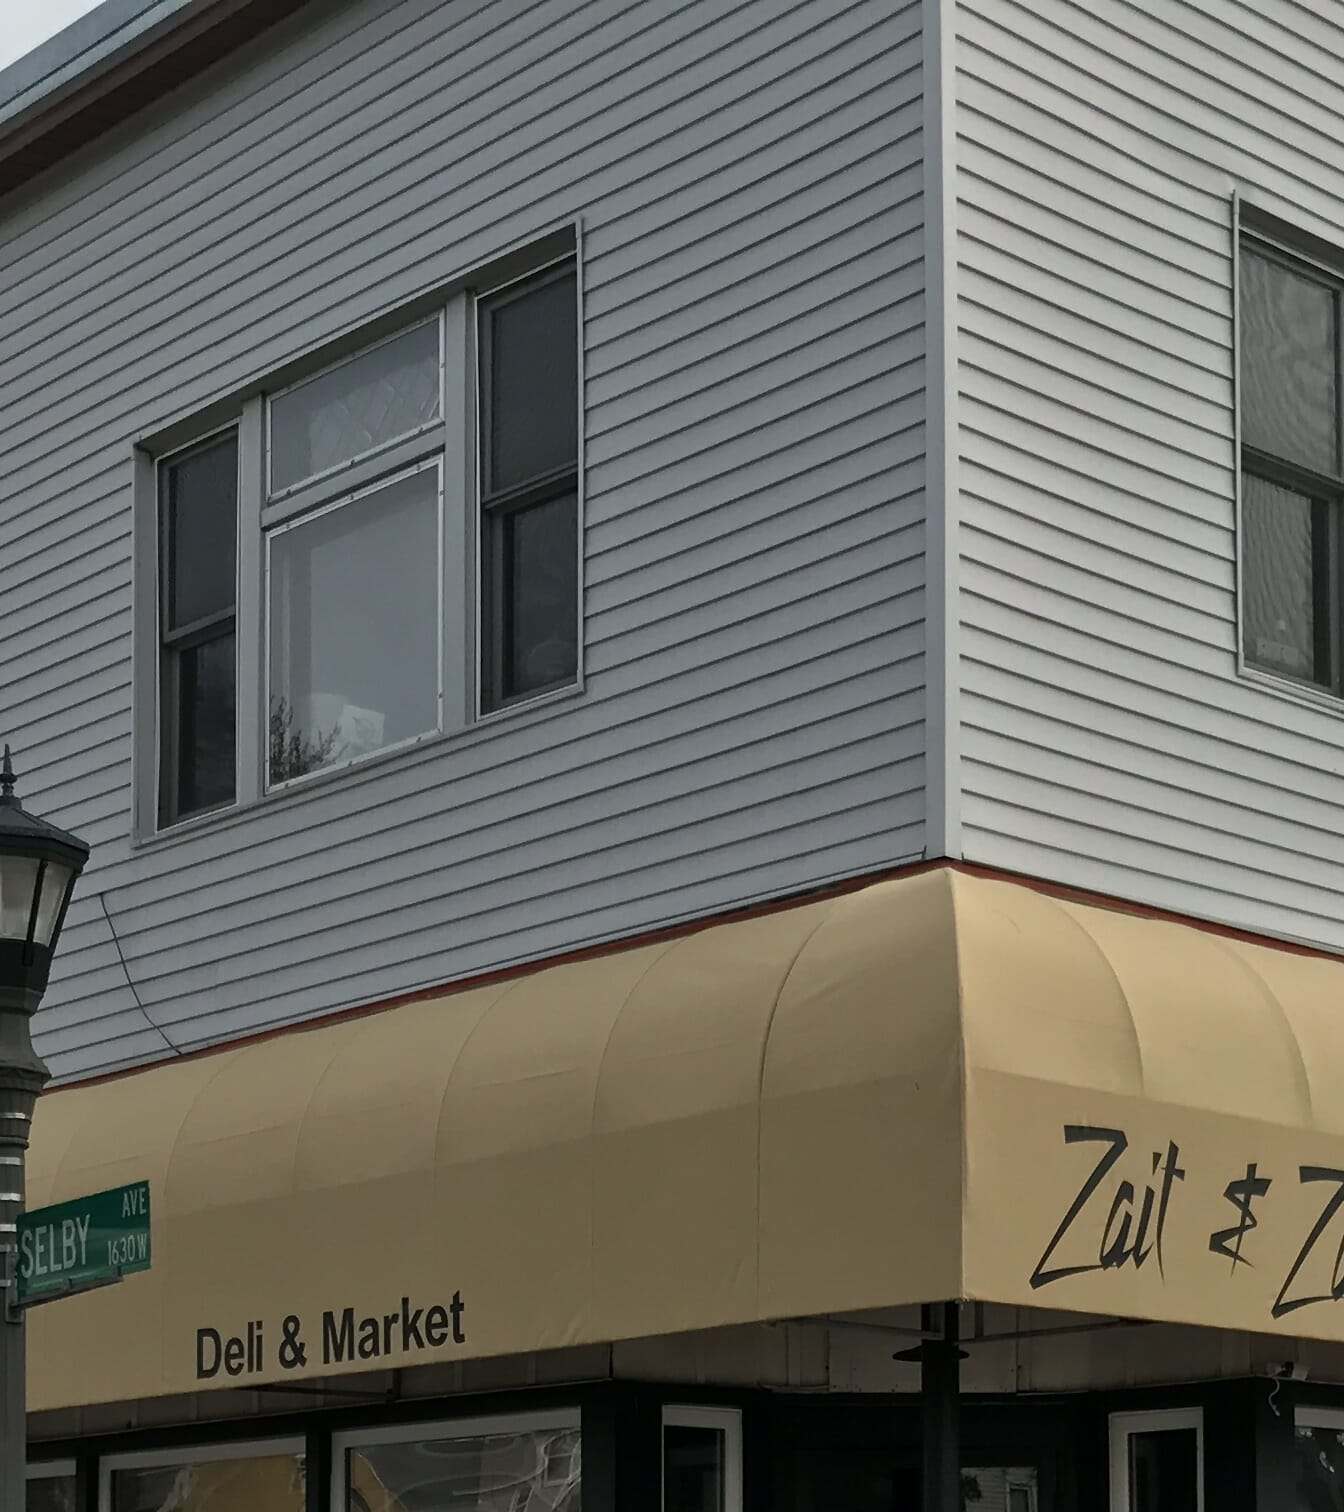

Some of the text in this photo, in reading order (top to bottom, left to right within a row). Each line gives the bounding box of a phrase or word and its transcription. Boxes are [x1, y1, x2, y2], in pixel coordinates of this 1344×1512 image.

[121, 1187, 147, 1218] AVE
[1029, 1124, 1186, 1290] Zait
[1208, 1162, 1272, 1277] &
[21, 1213, 90, 1278] SELBY
[196, 1290, 466, 1379] Deli & Market
